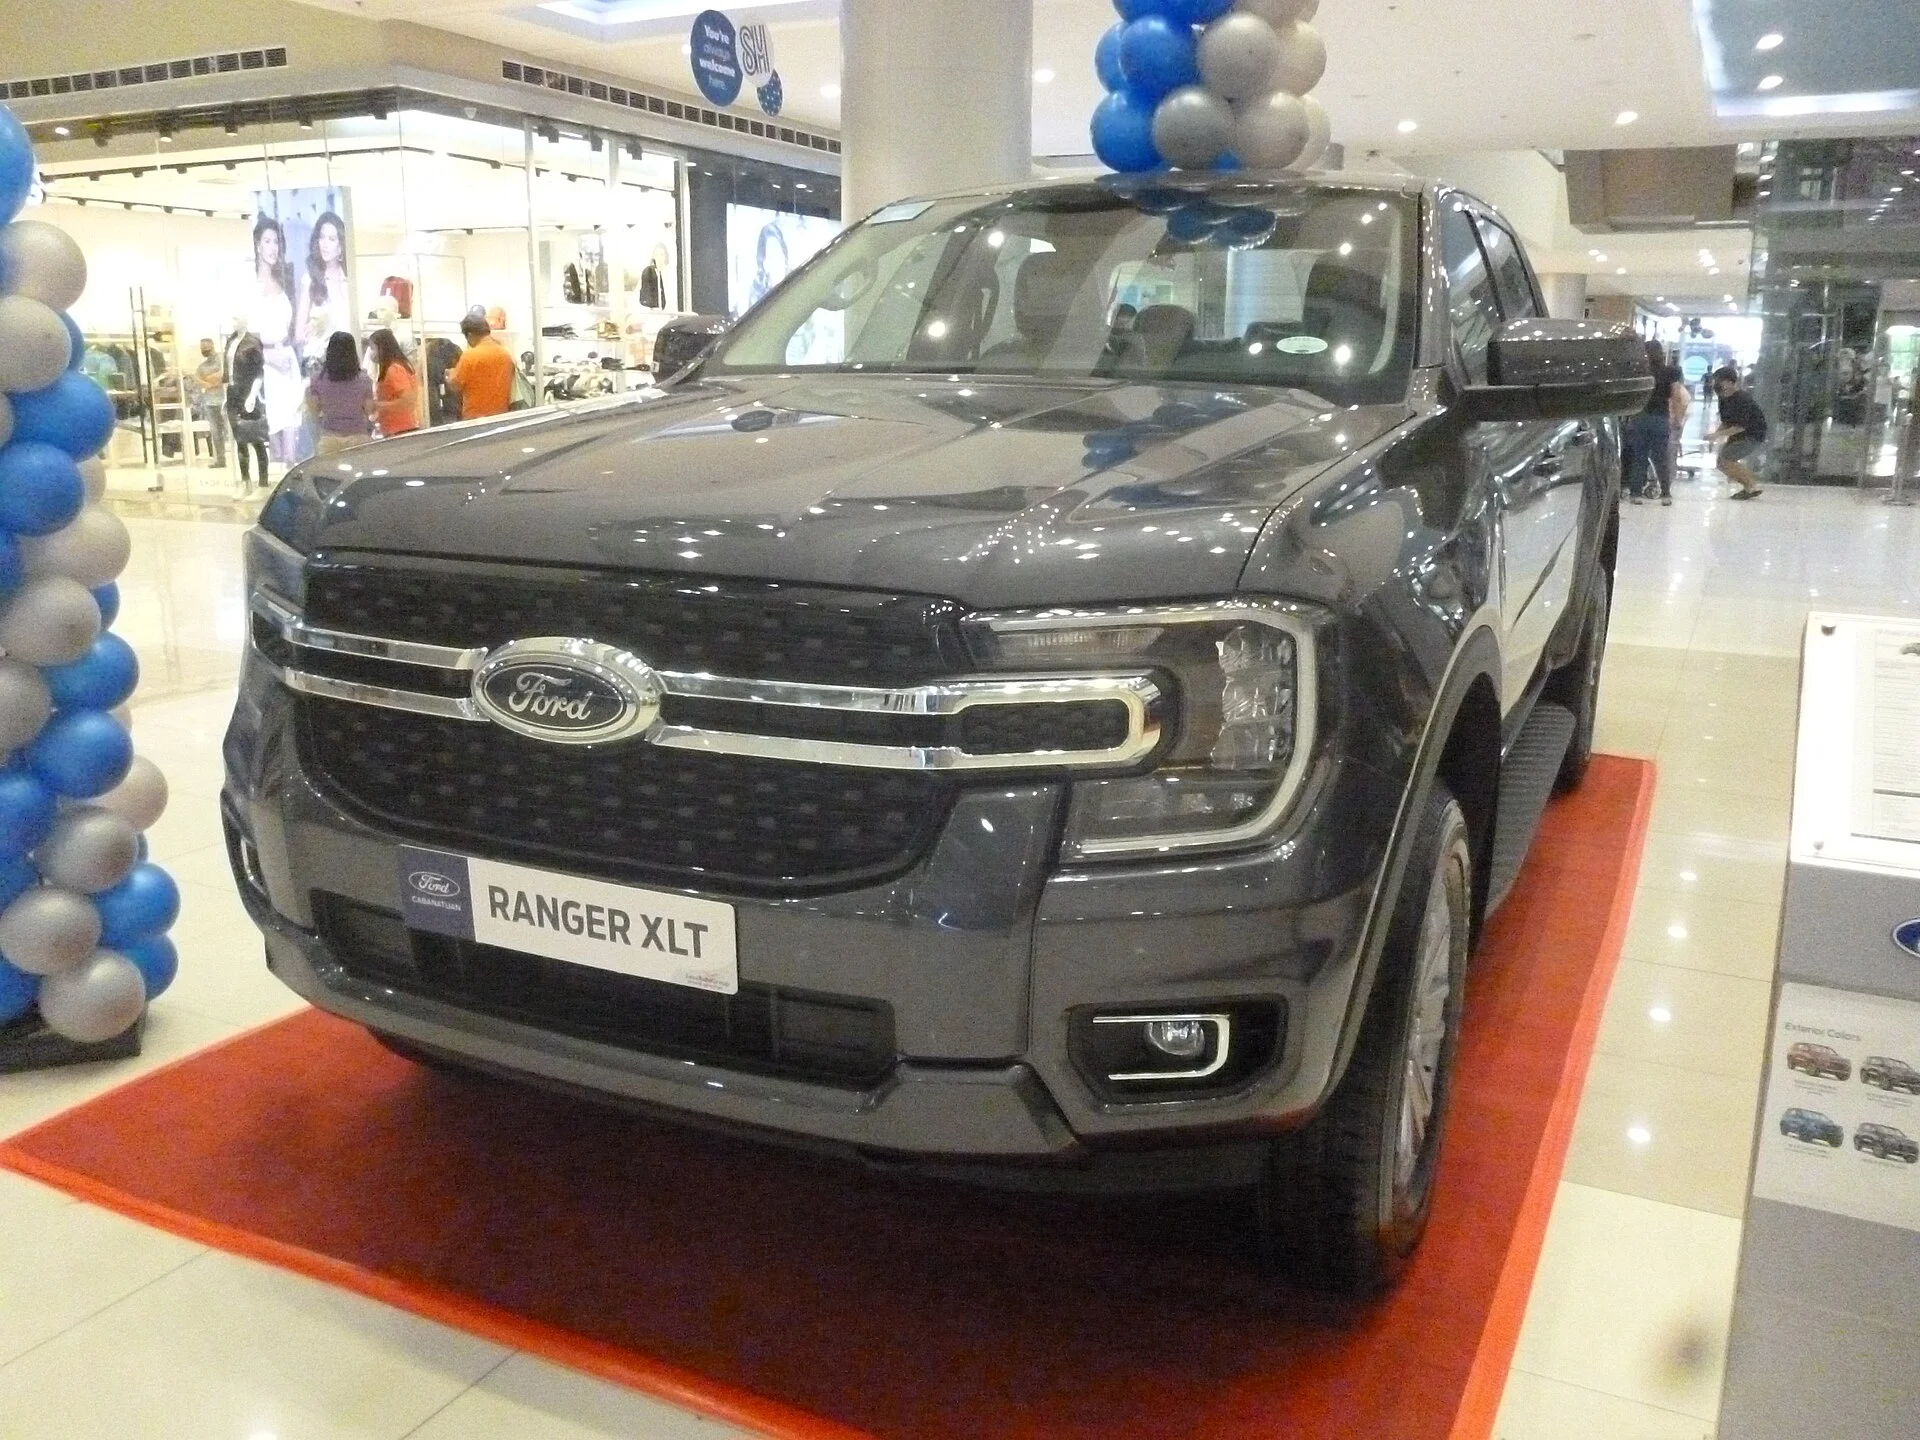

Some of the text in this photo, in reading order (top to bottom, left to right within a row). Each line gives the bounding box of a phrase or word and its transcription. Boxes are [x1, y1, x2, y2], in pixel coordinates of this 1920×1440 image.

[703, 24, 730, 46] You're
[699, 58, 736, 78] welcome
[508, 671, 593, 721] Ford
[418, 874, 450, 894] Ford
[488, 884, 708, 959] RANGER XLT
[1784, 1021, 1825, 1036] Exterior
